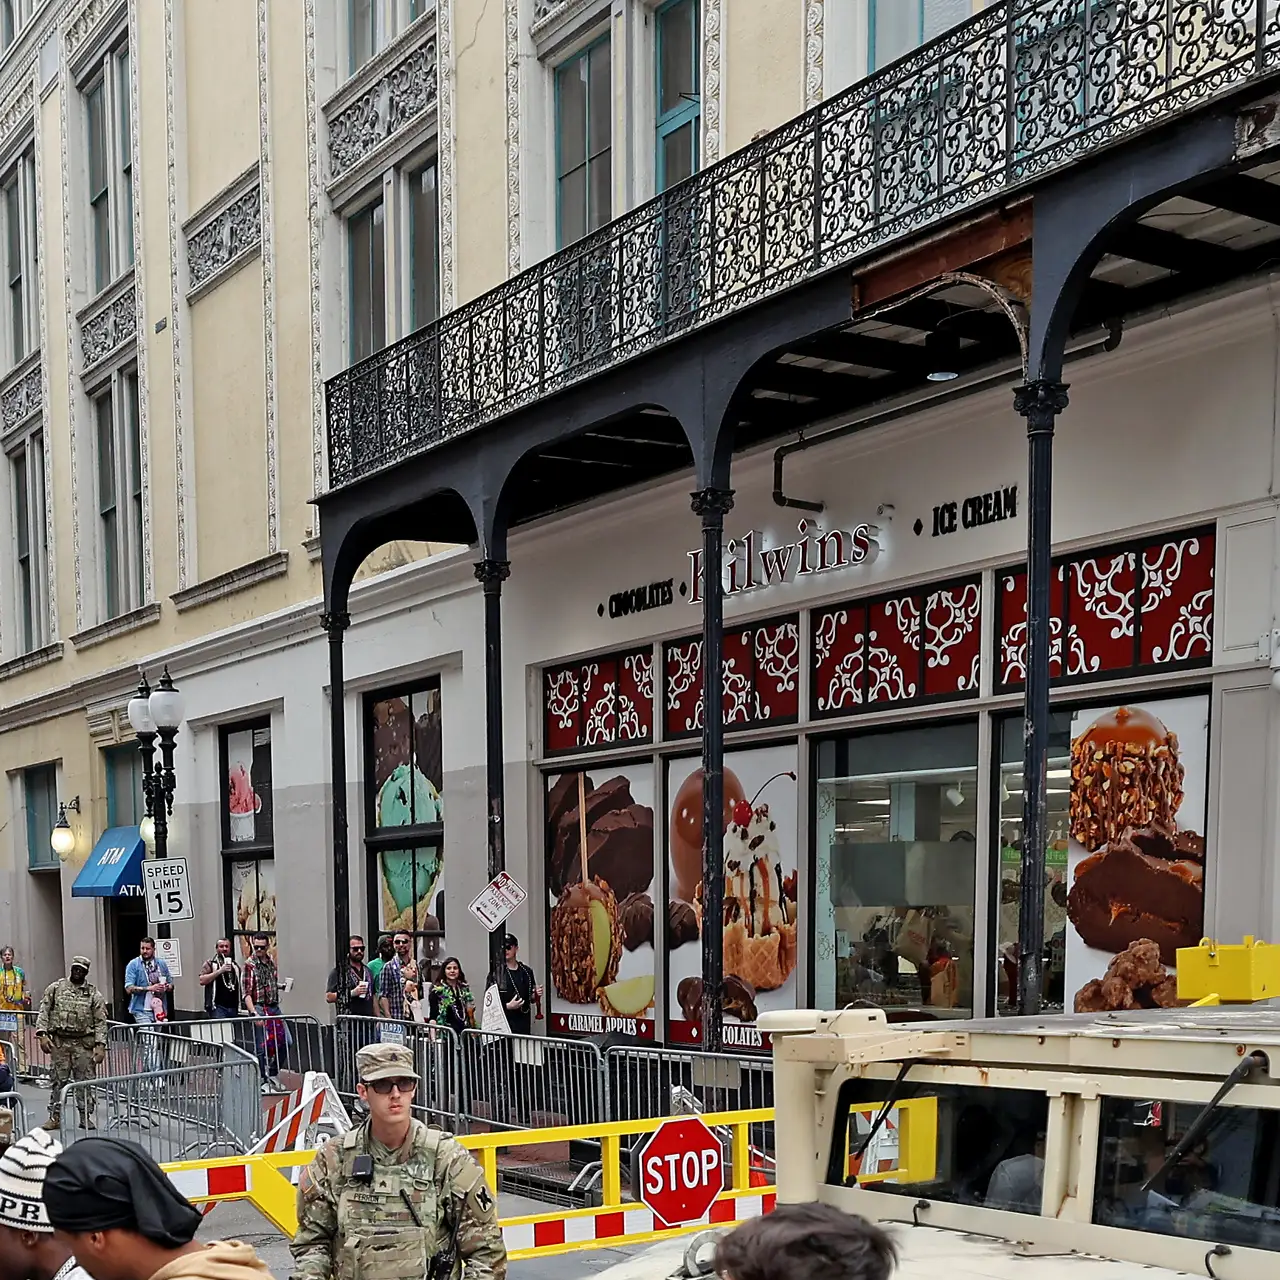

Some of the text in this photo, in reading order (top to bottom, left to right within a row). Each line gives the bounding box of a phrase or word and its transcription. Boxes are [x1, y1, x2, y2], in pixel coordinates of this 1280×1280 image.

[931, 484, 1019, 538] ICE CREAM
[608, 577, 674, 619] CHOCOLATES
[97, 847, 125, 867] ATM
[147, 865, 184, 878] SPEED
[119, 885, 146, 896] ATM
[153, 878, 181, 890] LIMIT
[155, 890, 184, 915] 15
[568, 1014, 637, 1036] CARAMEL APPLES
[722, 1025, 763, 1047] COLATES
[646, 1148, 719, 1195] STOP
